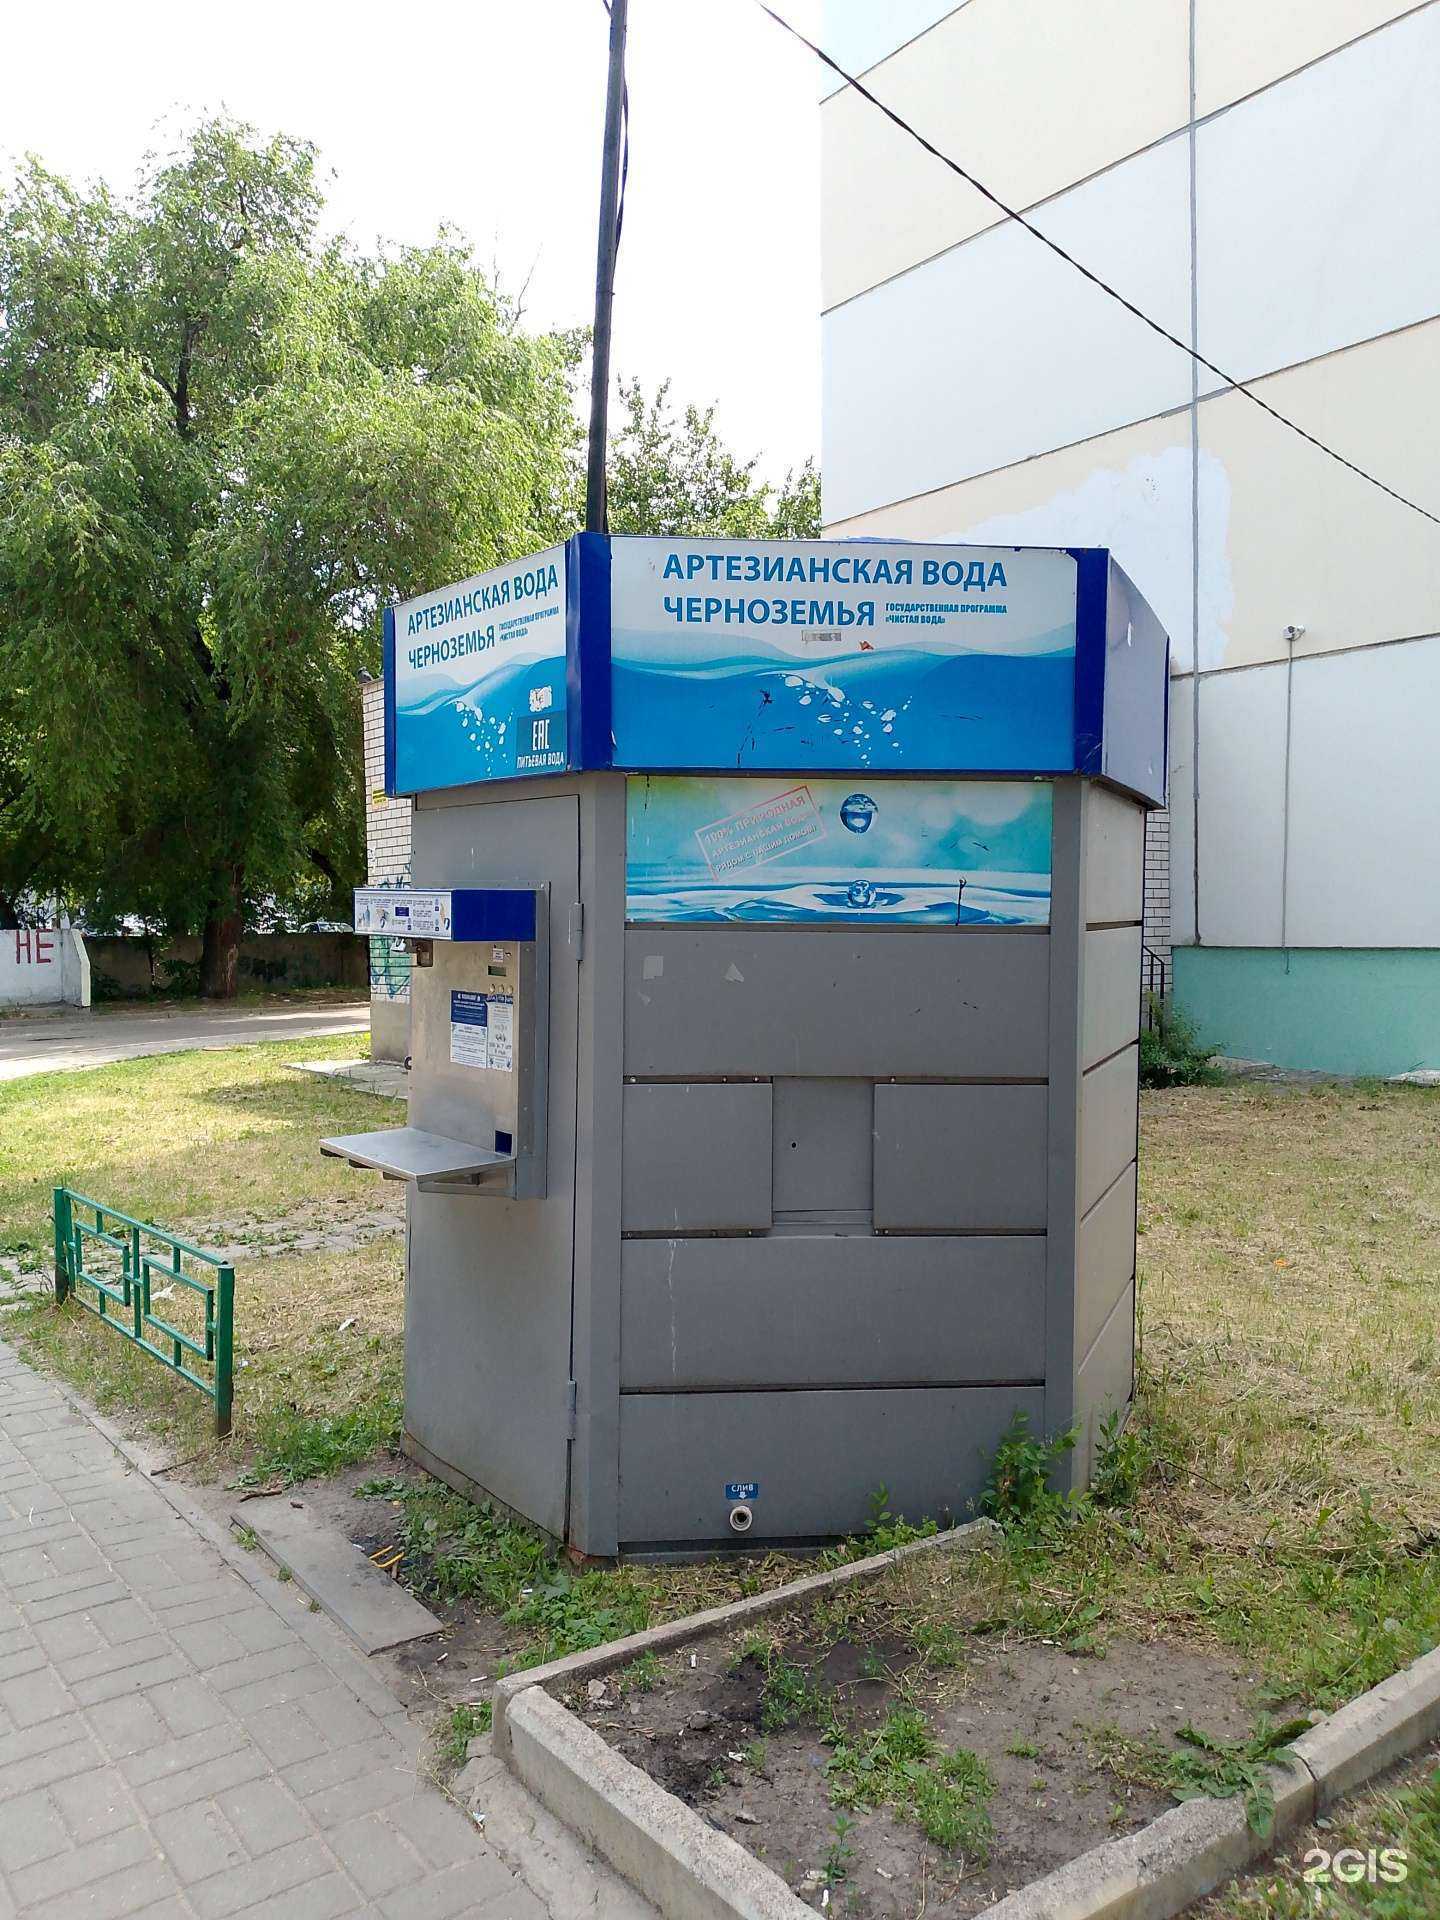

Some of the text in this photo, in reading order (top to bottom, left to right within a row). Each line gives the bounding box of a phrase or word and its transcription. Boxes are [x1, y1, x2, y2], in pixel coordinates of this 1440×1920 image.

[663, 553, 1007, 592] АРТЕЗИАНСКАЯ ВОДА
[408, 564, 558, 636] АРТЕЗИАНСКАЯ ВОДА
[663, 596, 875, 626] ЧЕРНОЗЕМЬЯ
[885, 603, 1008, 614] ГОСУДАРСТВЕННАЯ ПРОГРАММА
[885, 615, 946, 624] «ЧИСТАЯ ВОДА»
[408, 624, 495, 670] ЧЕРНОЗЕМЬЯ
[517, 752, 564, 768] ПИТЬЕВАЯ ВОДА
[735, 796, 806, 830] ПРИРОДНАЯ
[16, 928, 54, 964] НЕ
[731, 1484, 754, 1492] СЛИВ
